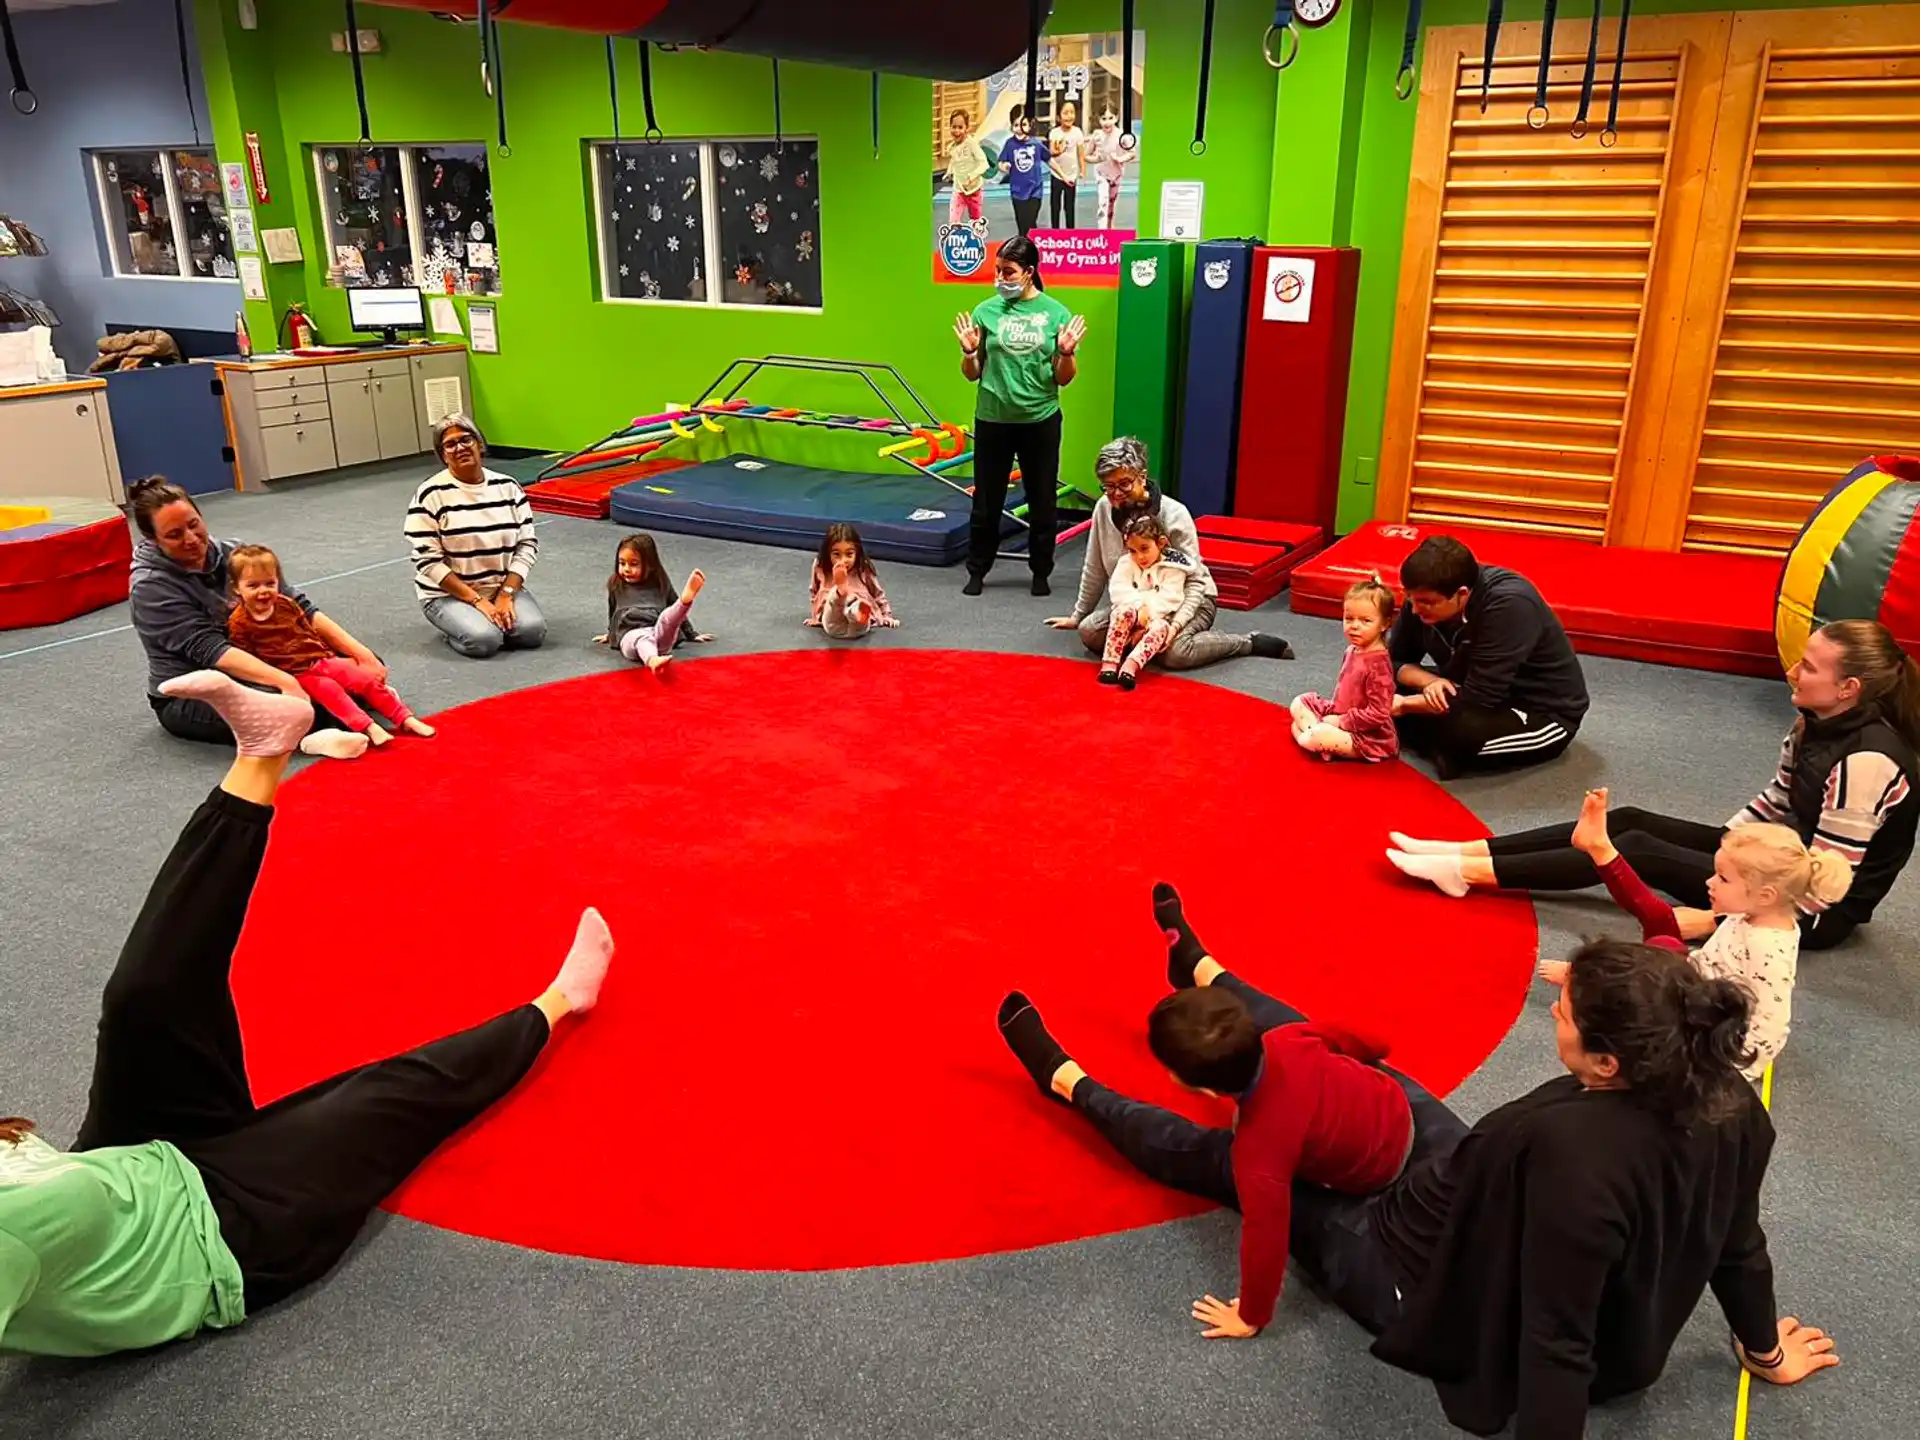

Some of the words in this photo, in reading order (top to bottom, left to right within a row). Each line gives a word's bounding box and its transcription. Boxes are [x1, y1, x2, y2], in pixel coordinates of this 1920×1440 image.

[1035, 236, 1083, 249] School's
[1042, 251, 1064, 267] My
[1067, 252, 1106, 267] Gym's
